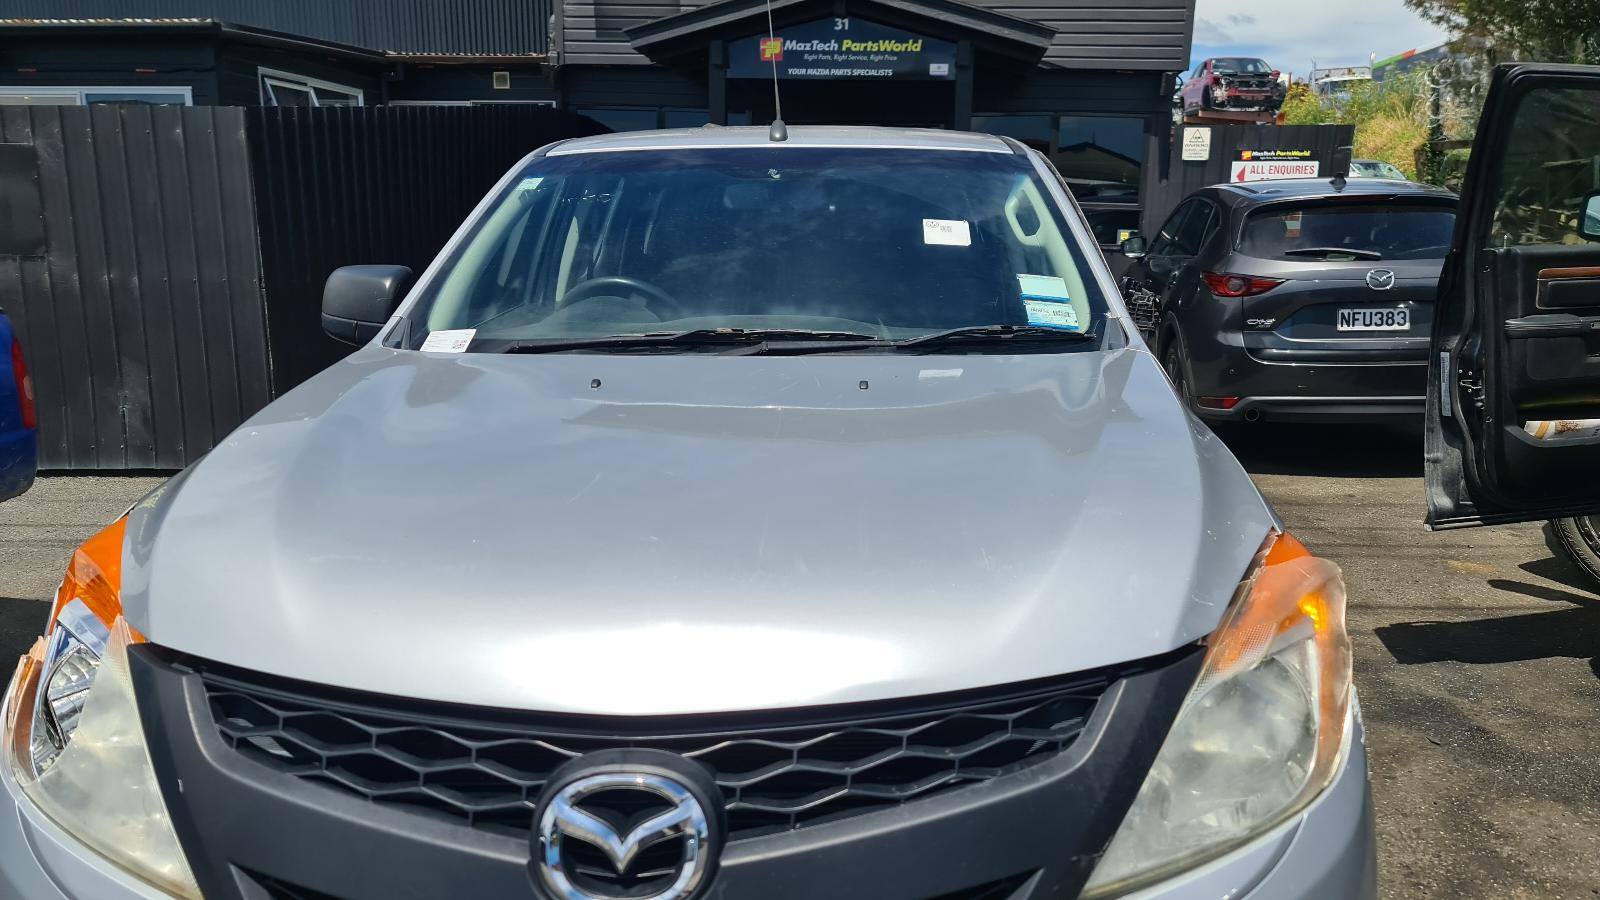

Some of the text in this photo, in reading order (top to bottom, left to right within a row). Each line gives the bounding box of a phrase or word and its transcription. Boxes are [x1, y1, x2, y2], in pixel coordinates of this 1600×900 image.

[834, 18, 849, 30] 31
[784, 39, 922, 52] MazTech PartsWorld
[1250, 165, 1315, 175] ALL ENQUIRIES
[1340, 311, 1407, 327] NFU383
